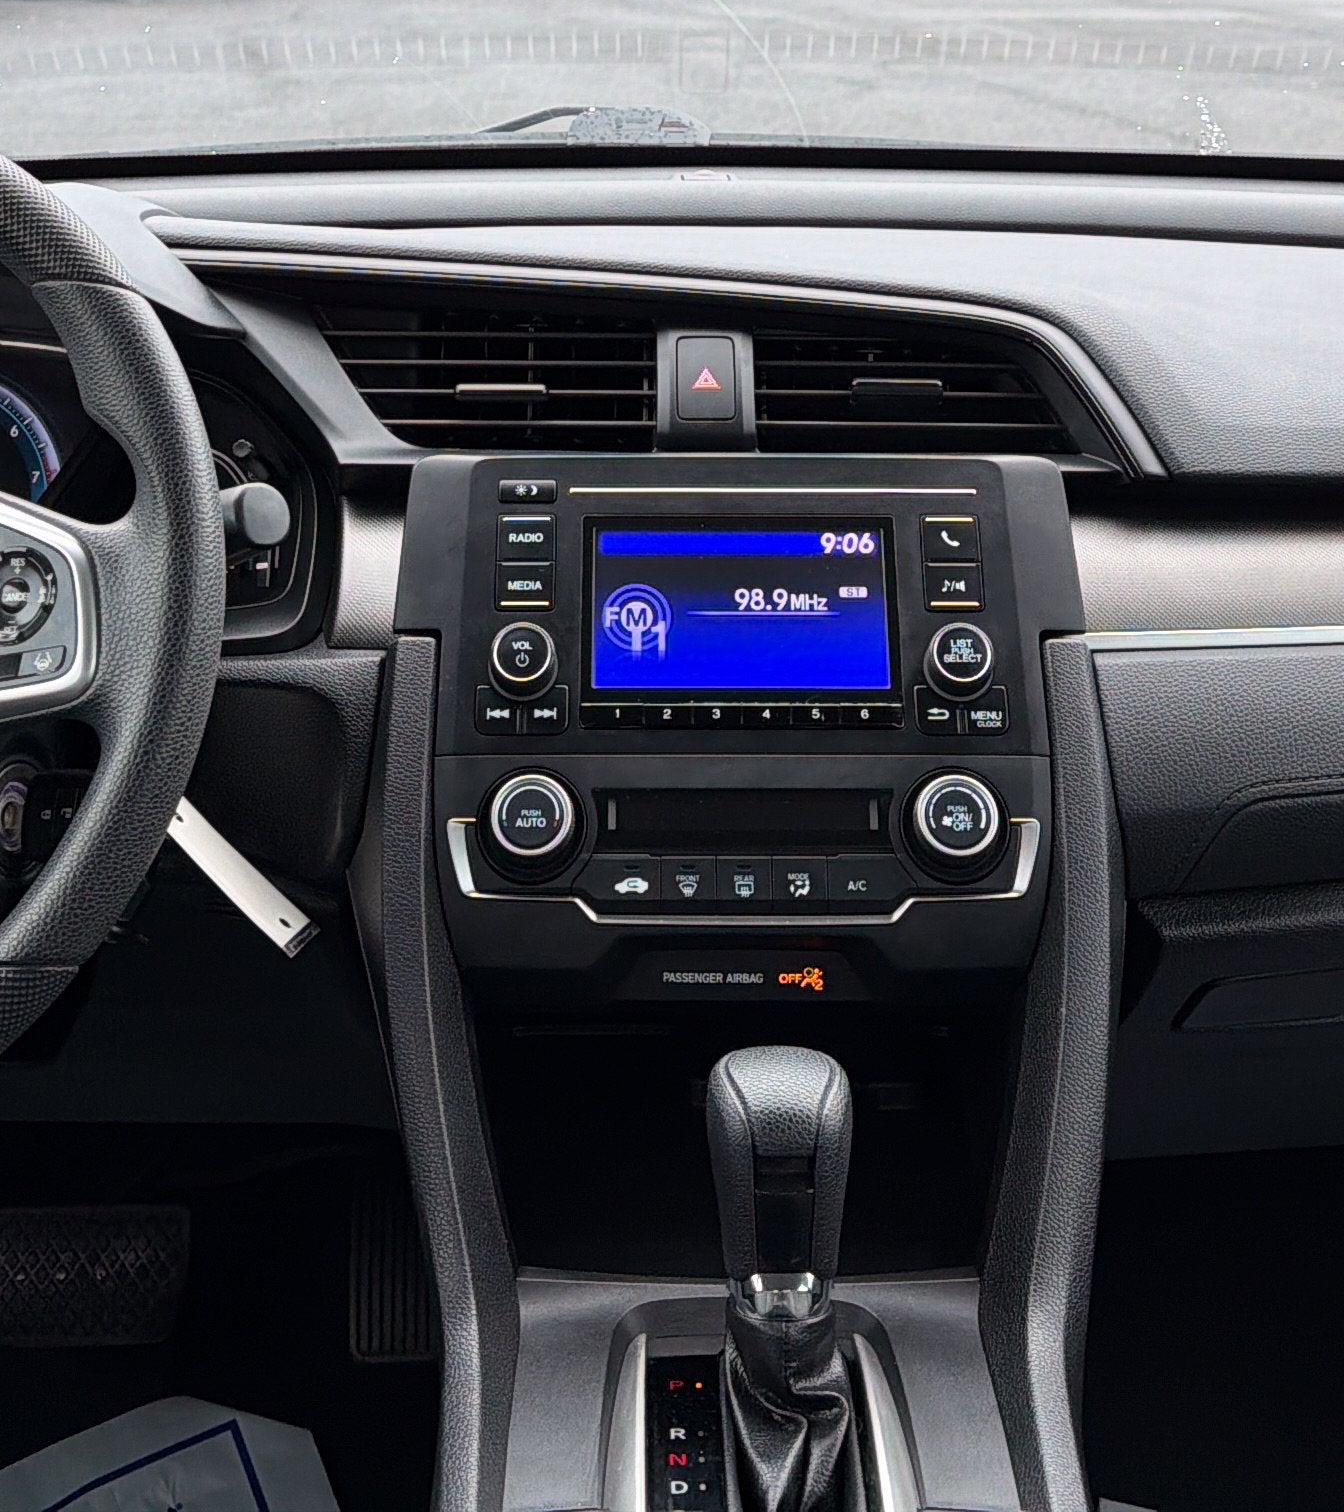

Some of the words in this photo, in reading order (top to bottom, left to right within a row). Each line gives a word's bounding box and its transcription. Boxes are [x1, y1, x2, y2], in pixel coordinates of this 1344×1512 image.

[10, 425, 19, 438] 6
[31, 471, 41, 483] 7
[508, 532, 544, 543] RADIO
[820, 532, 875, 554] 9:06
[11, 557, 26, 567] RES
[507, 580, 543, 590] MEDIA
[846, 587, 862, 598] ST
[512, 640, 533, 650] VOL
[950, 639, 973, 648] LIST
[944, 654, 982, 663] SELECT
[615, 708, 621, 719] 1
[662, 708, 673, 719] 2
[712, 708, 721, 719] 3
[762, 708, 771, 719] 4
[811, 708, 821, 719] 5
[860, 708, 870, 719] 6
[971, 710, 1002, 720] MENU
[521, 809, 542, 817] PUSH
[515, 817, 547, 828] AUTO
[952, 821, 974, 832] OFF
[676, 874, 700, 883] FRONT
[847, 880, 867, 891] A/C
[662, 971, 723, 984] PASSENGER
[725, 972, 764, 984] AIRBAG
[778, 973, 803, 984] OFF
[669, 1381, 685, 1391] P
[670, 1428, 686, 1440] R
[669, 1453, 688, 1466] N
[670, 1481, 689, 1495] D
